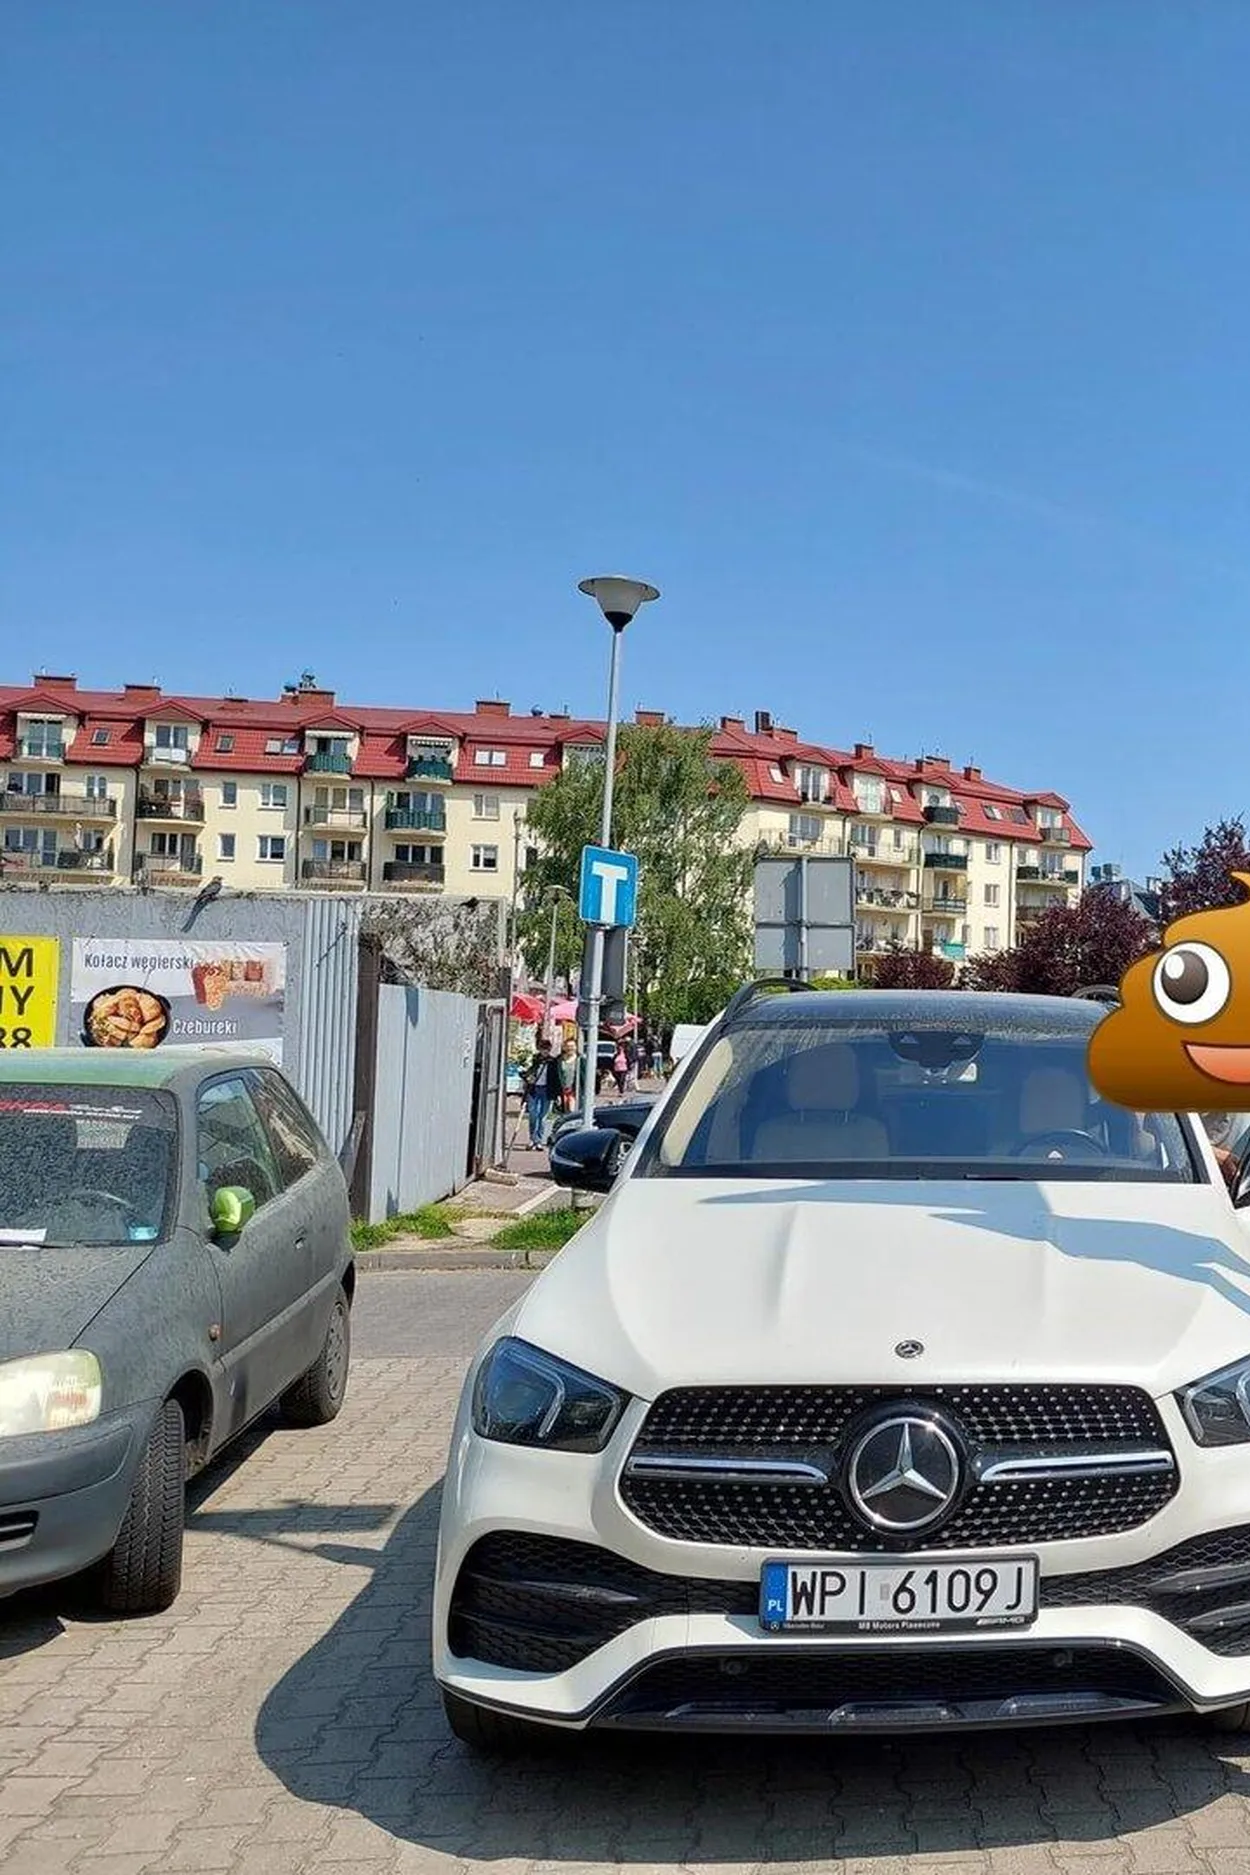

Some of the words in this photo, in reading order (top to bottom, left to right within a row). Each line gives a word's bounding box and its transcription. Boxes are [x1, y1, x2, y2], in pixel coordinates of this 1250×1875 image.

[85, 953, 127, 970] Kołacz
[130, 954, 194, 973] węgierski
[173, 1019, 237, 1034] Czebureki
[891, 1567, 1023, 1614] 6109J
[768, 1600, 783, 1612] PL
[873, 1621, 899, 1631] Motors
